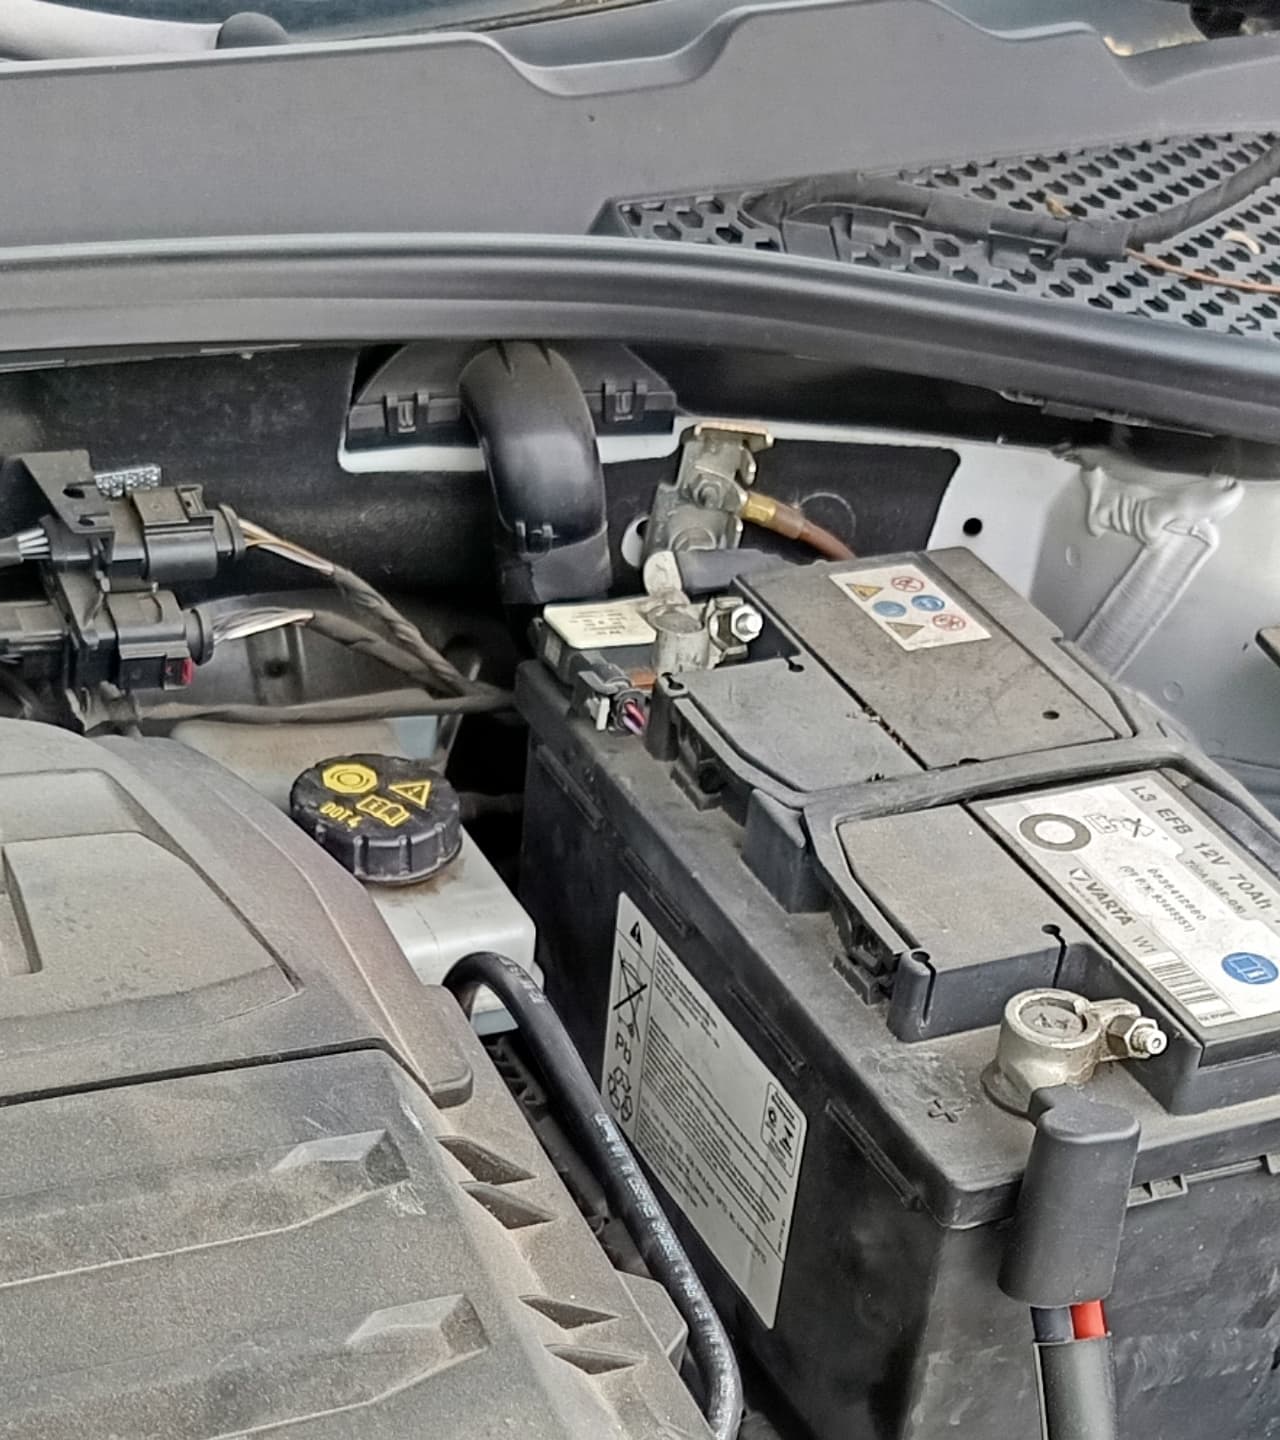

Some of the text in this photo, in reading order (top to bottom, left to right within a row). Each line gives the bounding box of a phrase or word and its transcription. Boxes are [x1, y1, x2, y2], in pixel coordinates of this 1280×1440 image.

[321, 801, 363, 828] DOT 4
[1131, 786, 1157, 803] L3
[1155, 808, 1194, 835] EFB
[1192, 842, 1230, 867] 12V
[1228, 874, 1273, 909] 70Ah
[1084, 883, 1133, 926] VARTA
